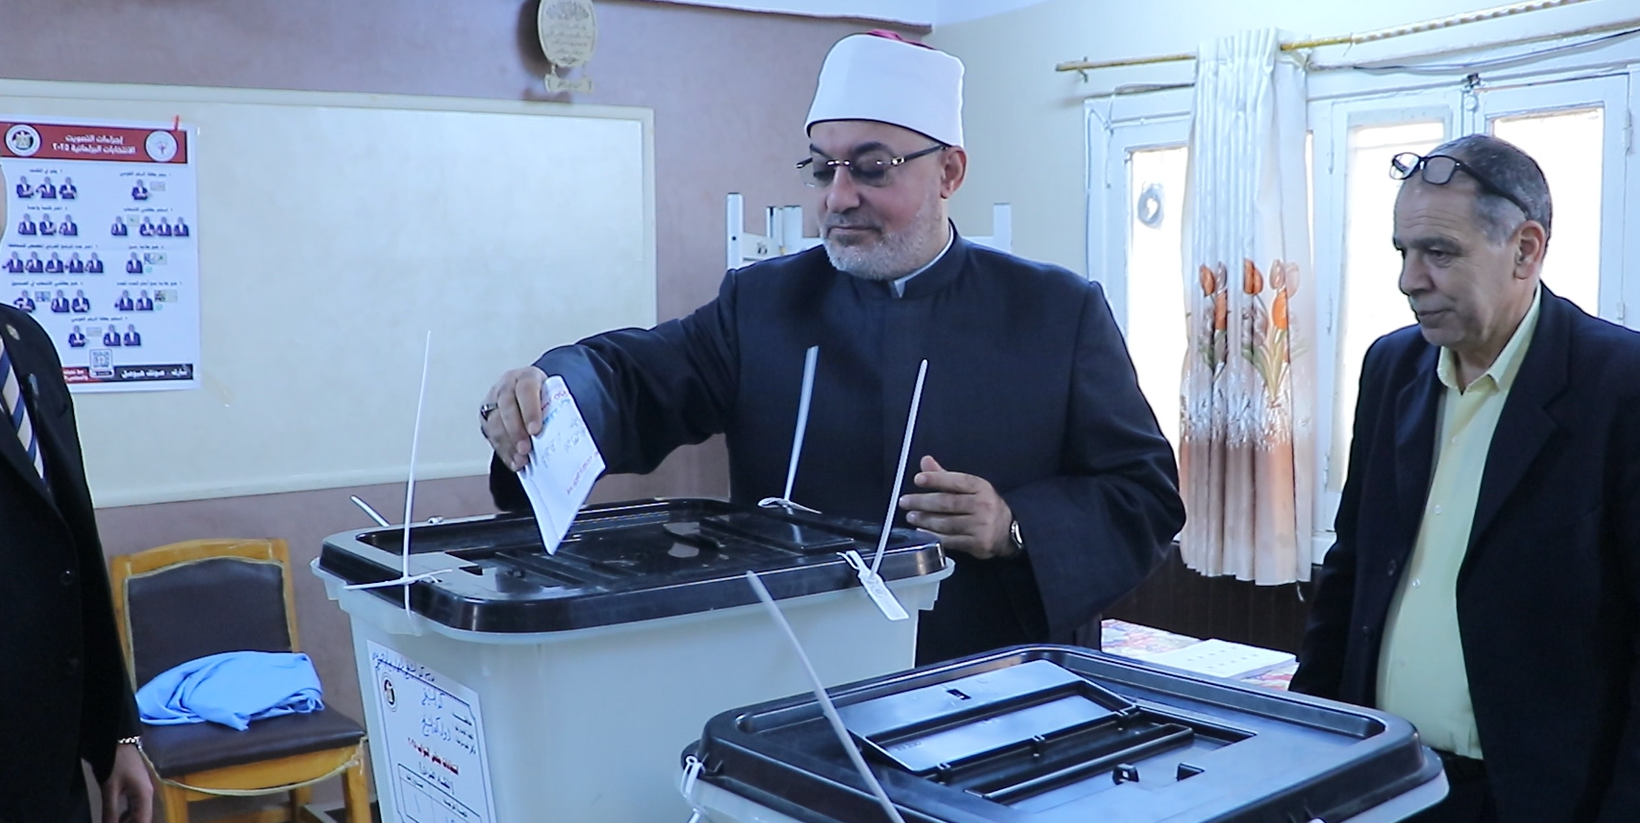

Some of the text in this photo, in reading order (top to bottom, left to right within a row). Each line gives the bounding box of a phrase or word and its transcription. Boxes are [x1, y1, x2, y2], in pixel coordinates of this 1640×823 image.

[65, 134, 124, 145] إجراءات التصويت
[71, 143, 101, 153] البرلمانية
[103, 145, 136, 154] الانتخابات
